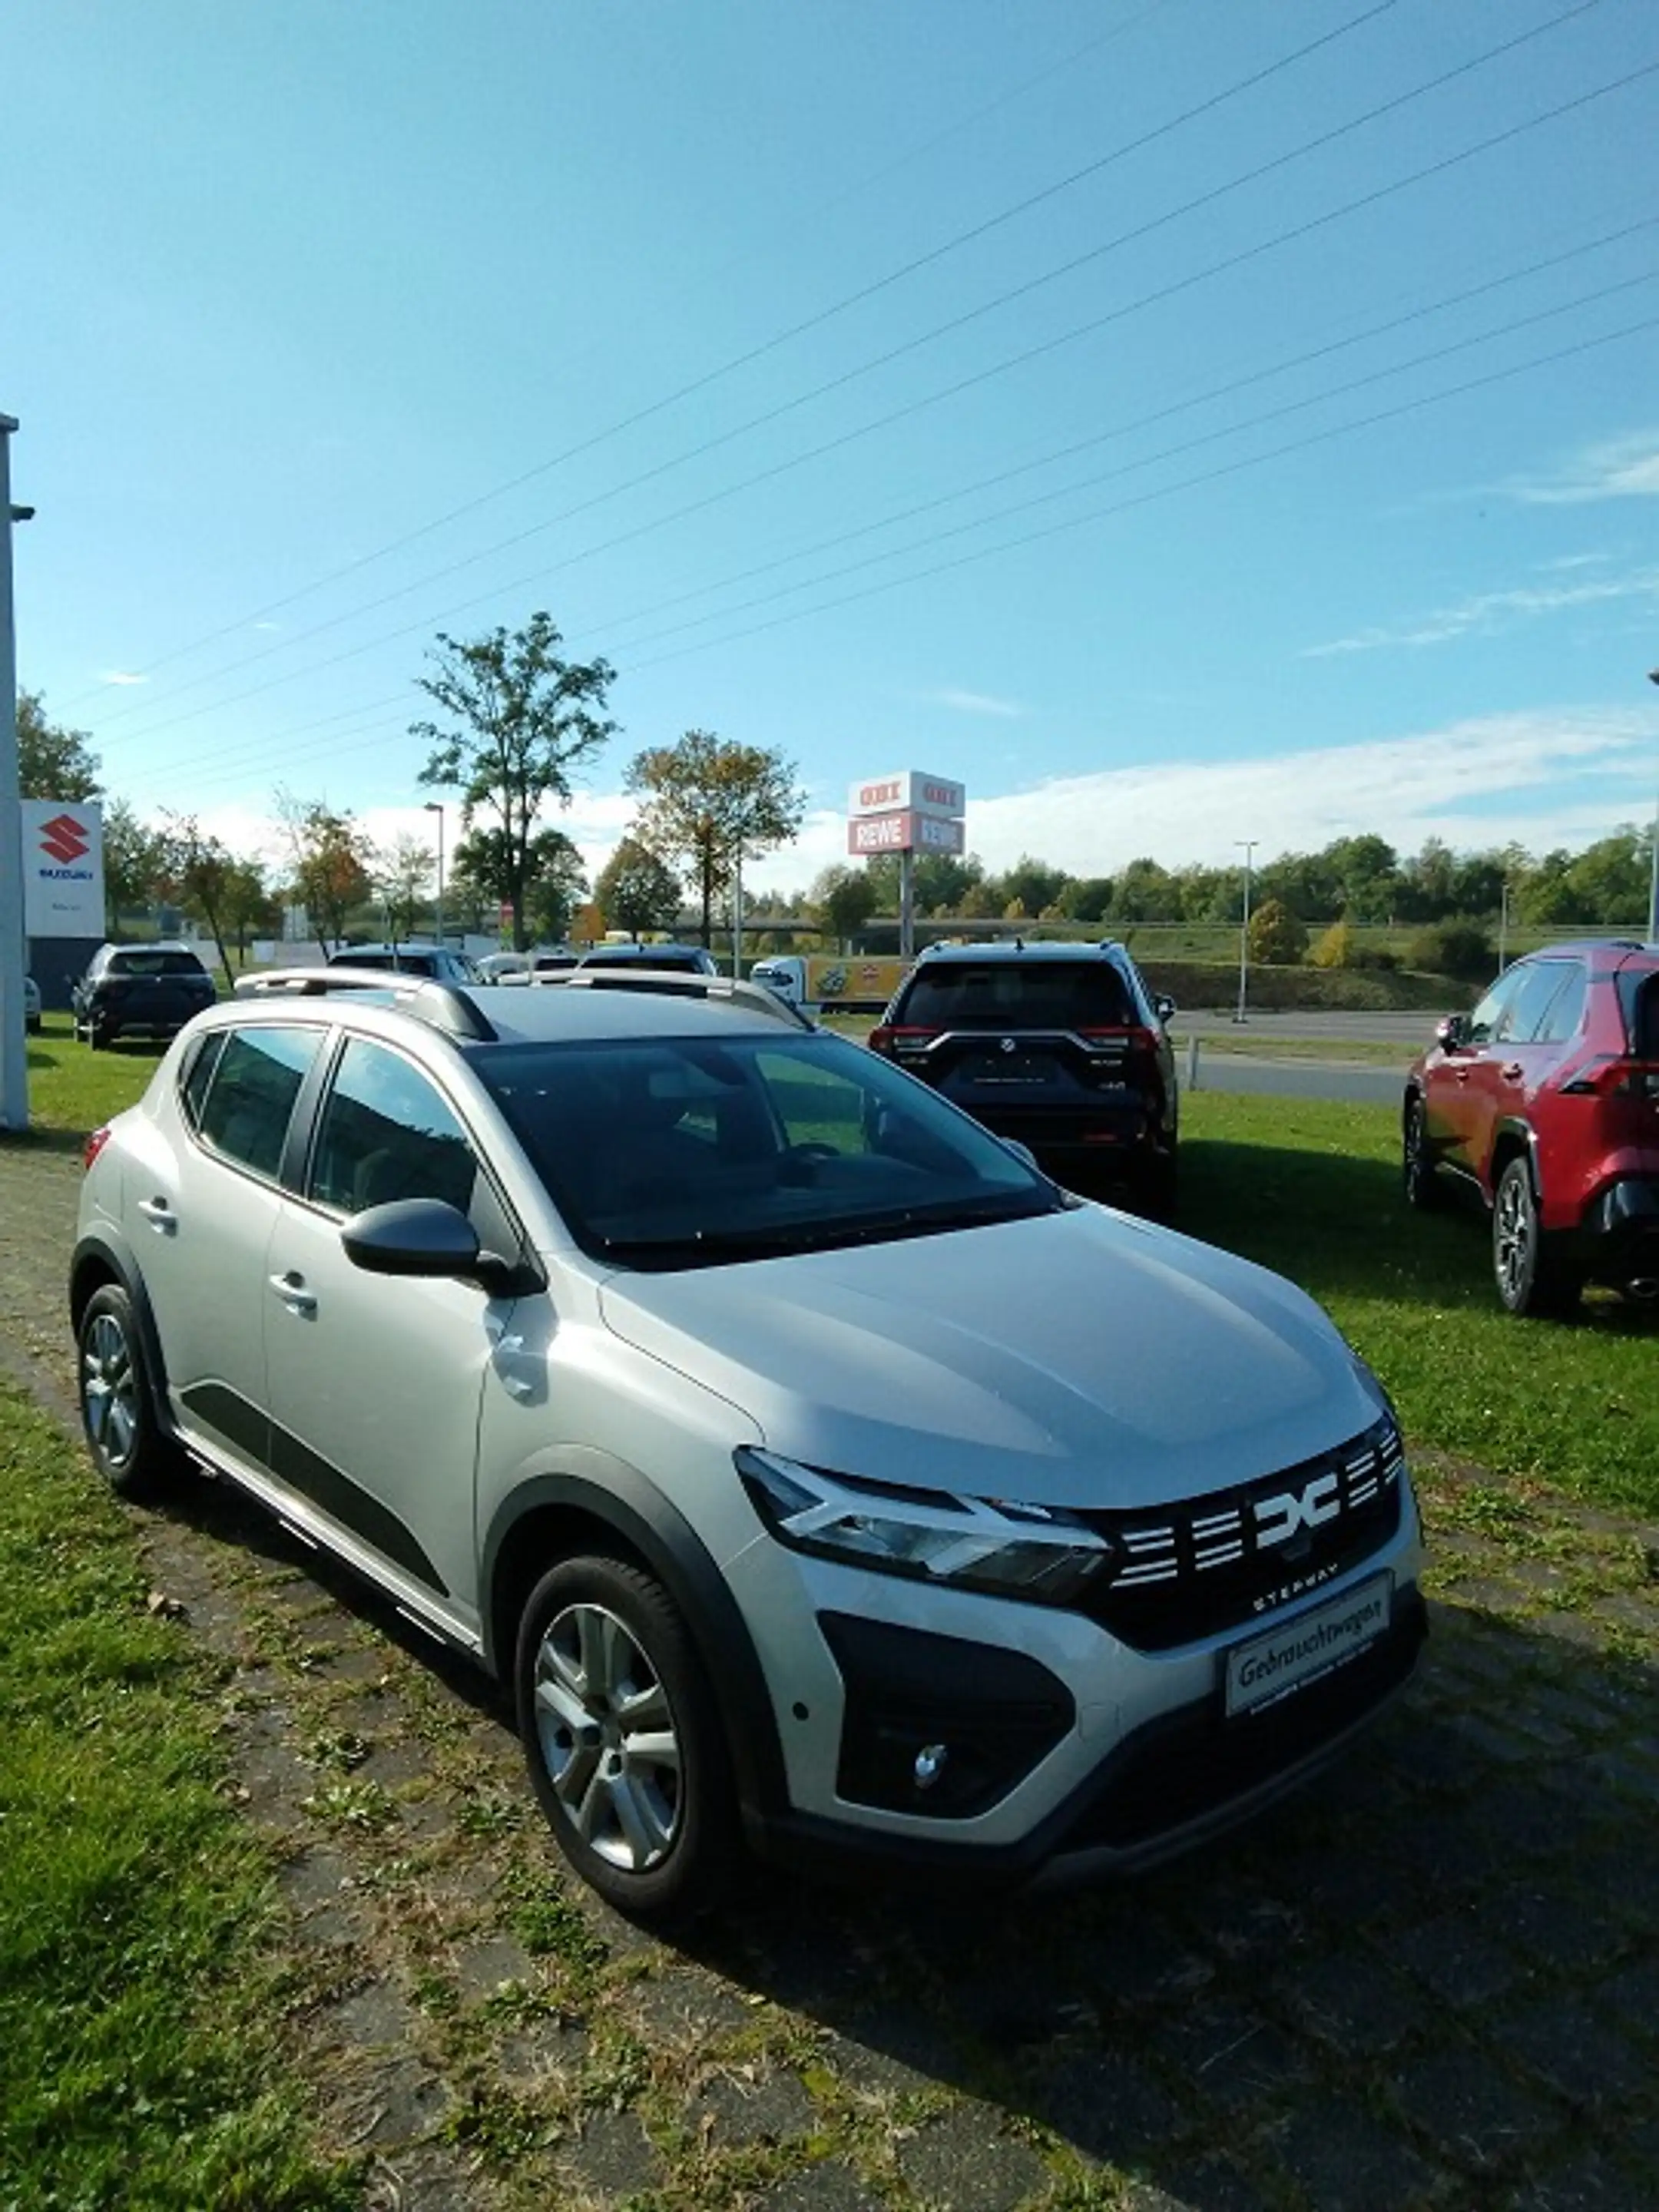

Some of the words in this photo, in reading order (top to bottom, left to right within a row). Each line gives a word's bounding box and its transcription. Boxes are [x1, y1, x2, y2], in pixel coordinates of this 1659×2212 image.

[856, 817, 902, 848] REWE
[38, 869, 94, 880] SUZUKI
[1253, 1562, 1338, 1611] STEPWAY
[1238, 1598, 1382, 1688] Gebrauchtwagen
